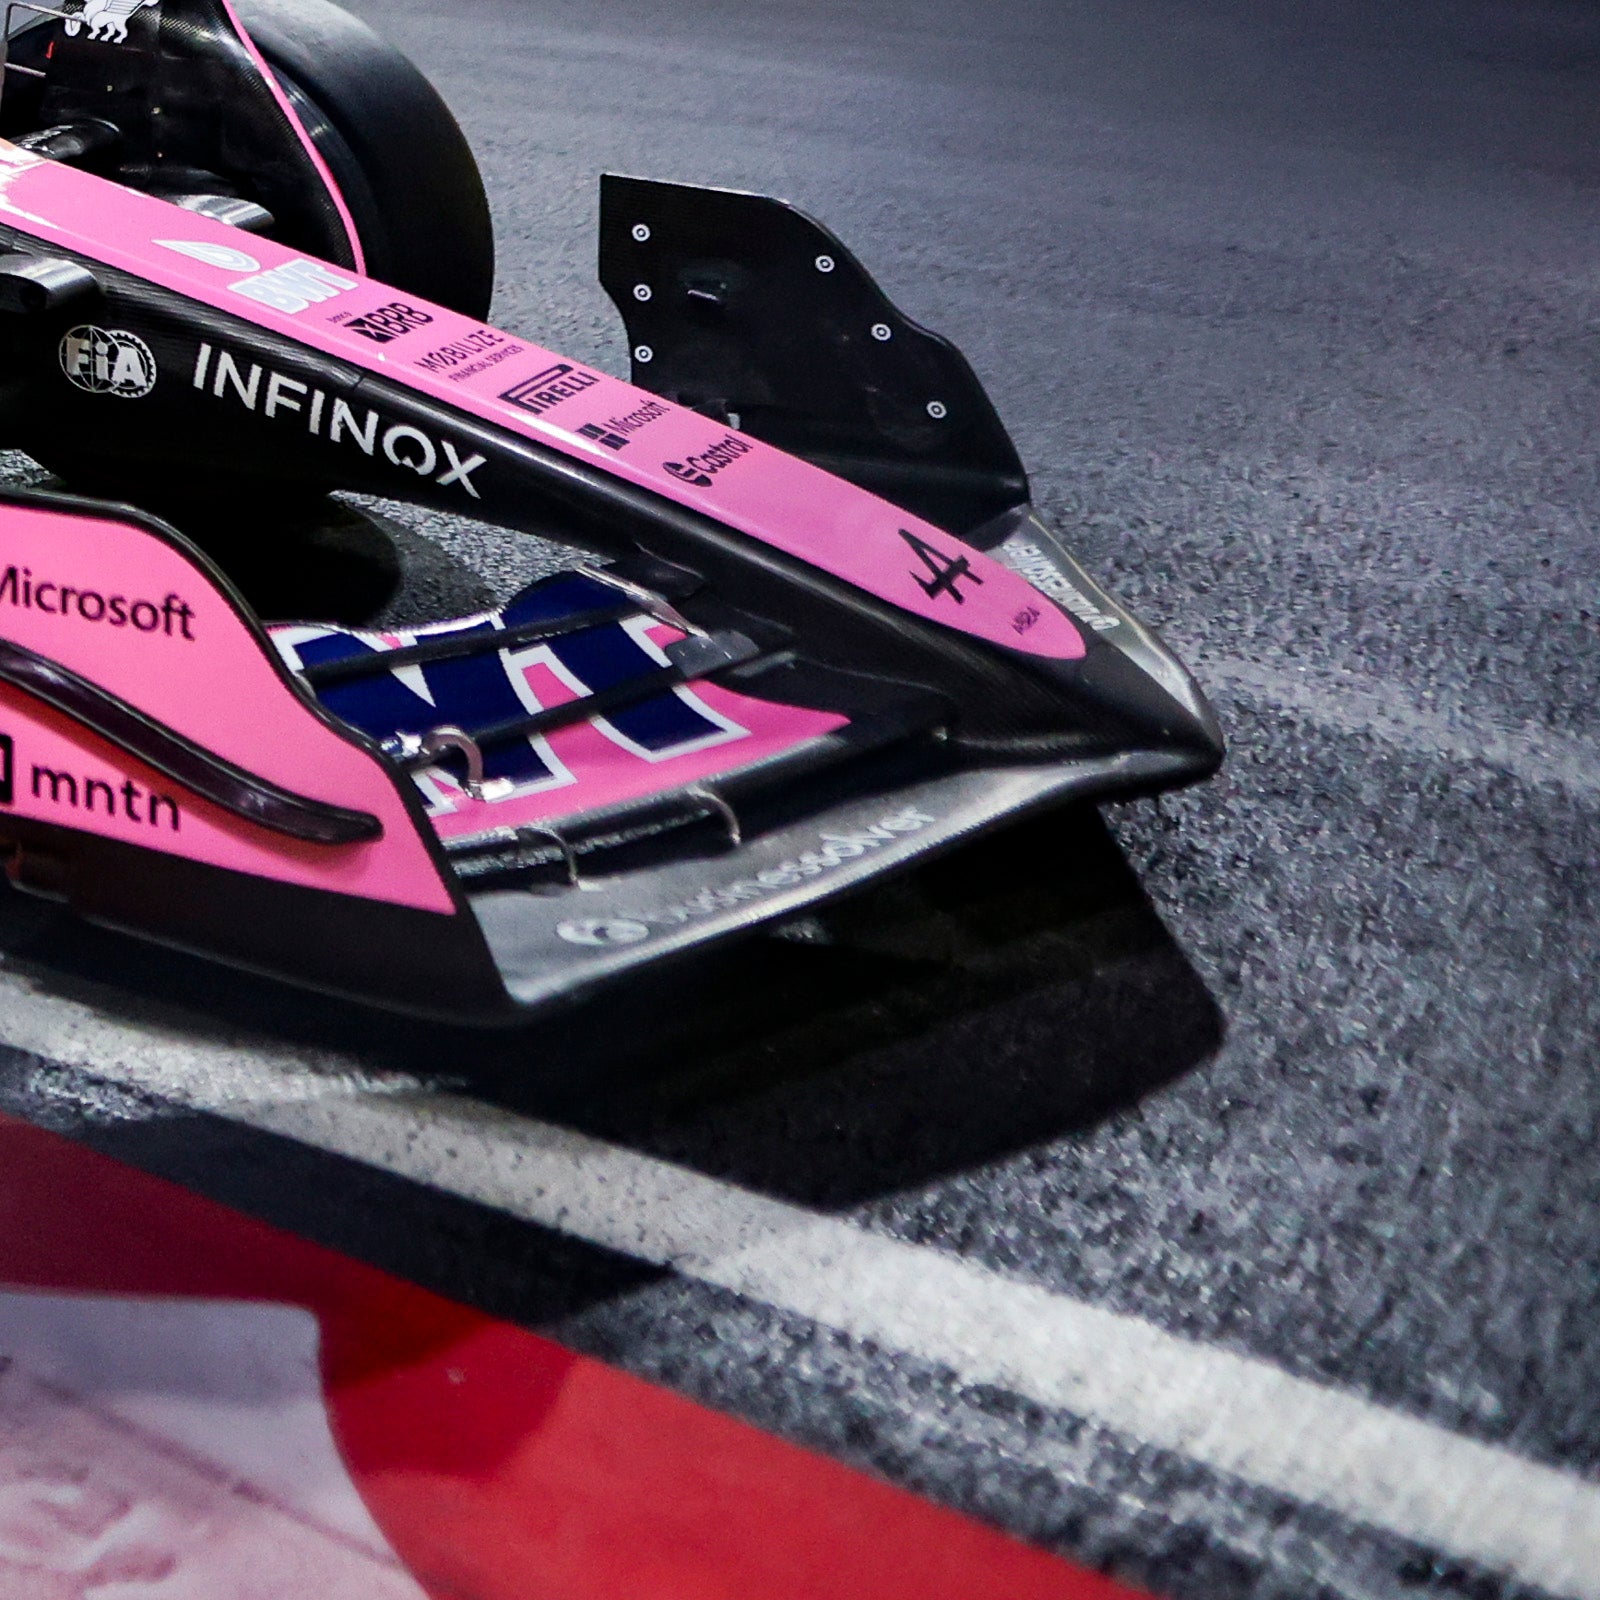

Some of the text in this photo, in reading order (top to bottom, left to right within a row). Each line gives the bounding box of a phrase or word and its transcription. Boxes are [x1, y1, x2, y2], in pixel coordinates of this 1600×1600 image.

[226, 256, 361, 315] BWT
[497, 363, 601, 416] PIRELLI
[603, 398, 671, 437] Microsoft
[193, 342, 488, 499] INFINOX
[690, 433, 754, 474] Castrol
[30, 759, 182, 833] mntn
